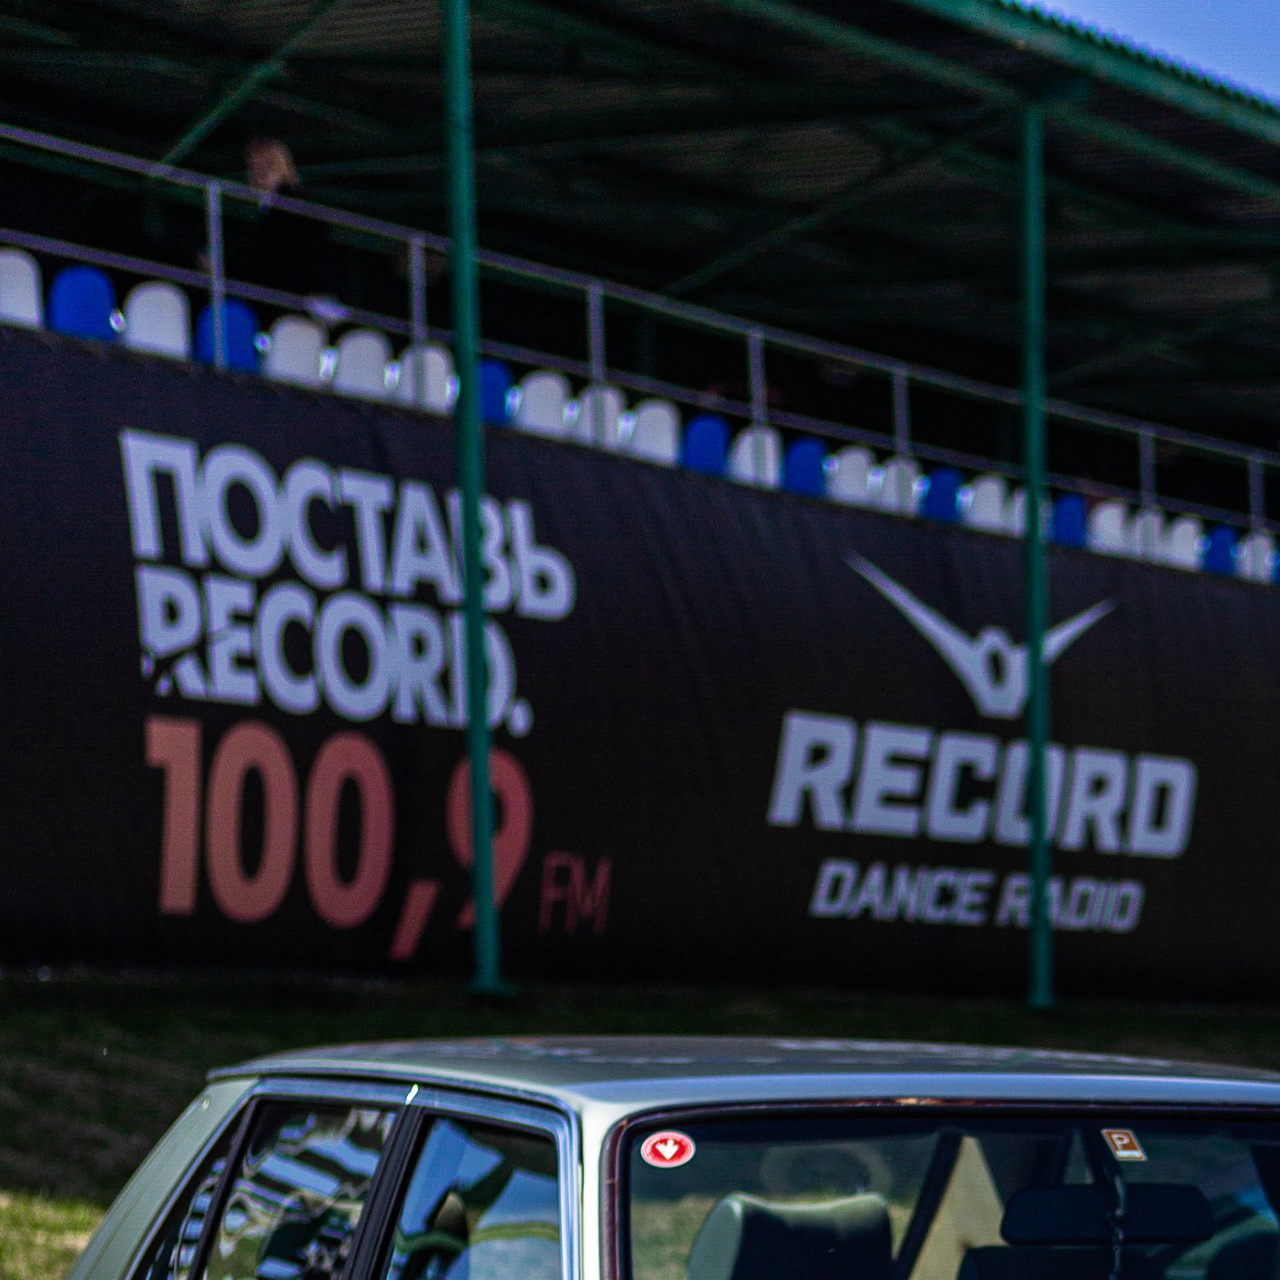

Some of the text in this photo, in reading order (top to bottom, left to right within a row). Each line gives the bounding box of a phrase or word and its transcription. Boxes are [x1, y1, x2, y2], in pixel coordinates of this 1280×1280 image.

[145, 714, 613, 960] 100,9 FM
[767, 711, 1197, 859] RECORD
[809, 858, 1146, 934] DANCE RDIO
